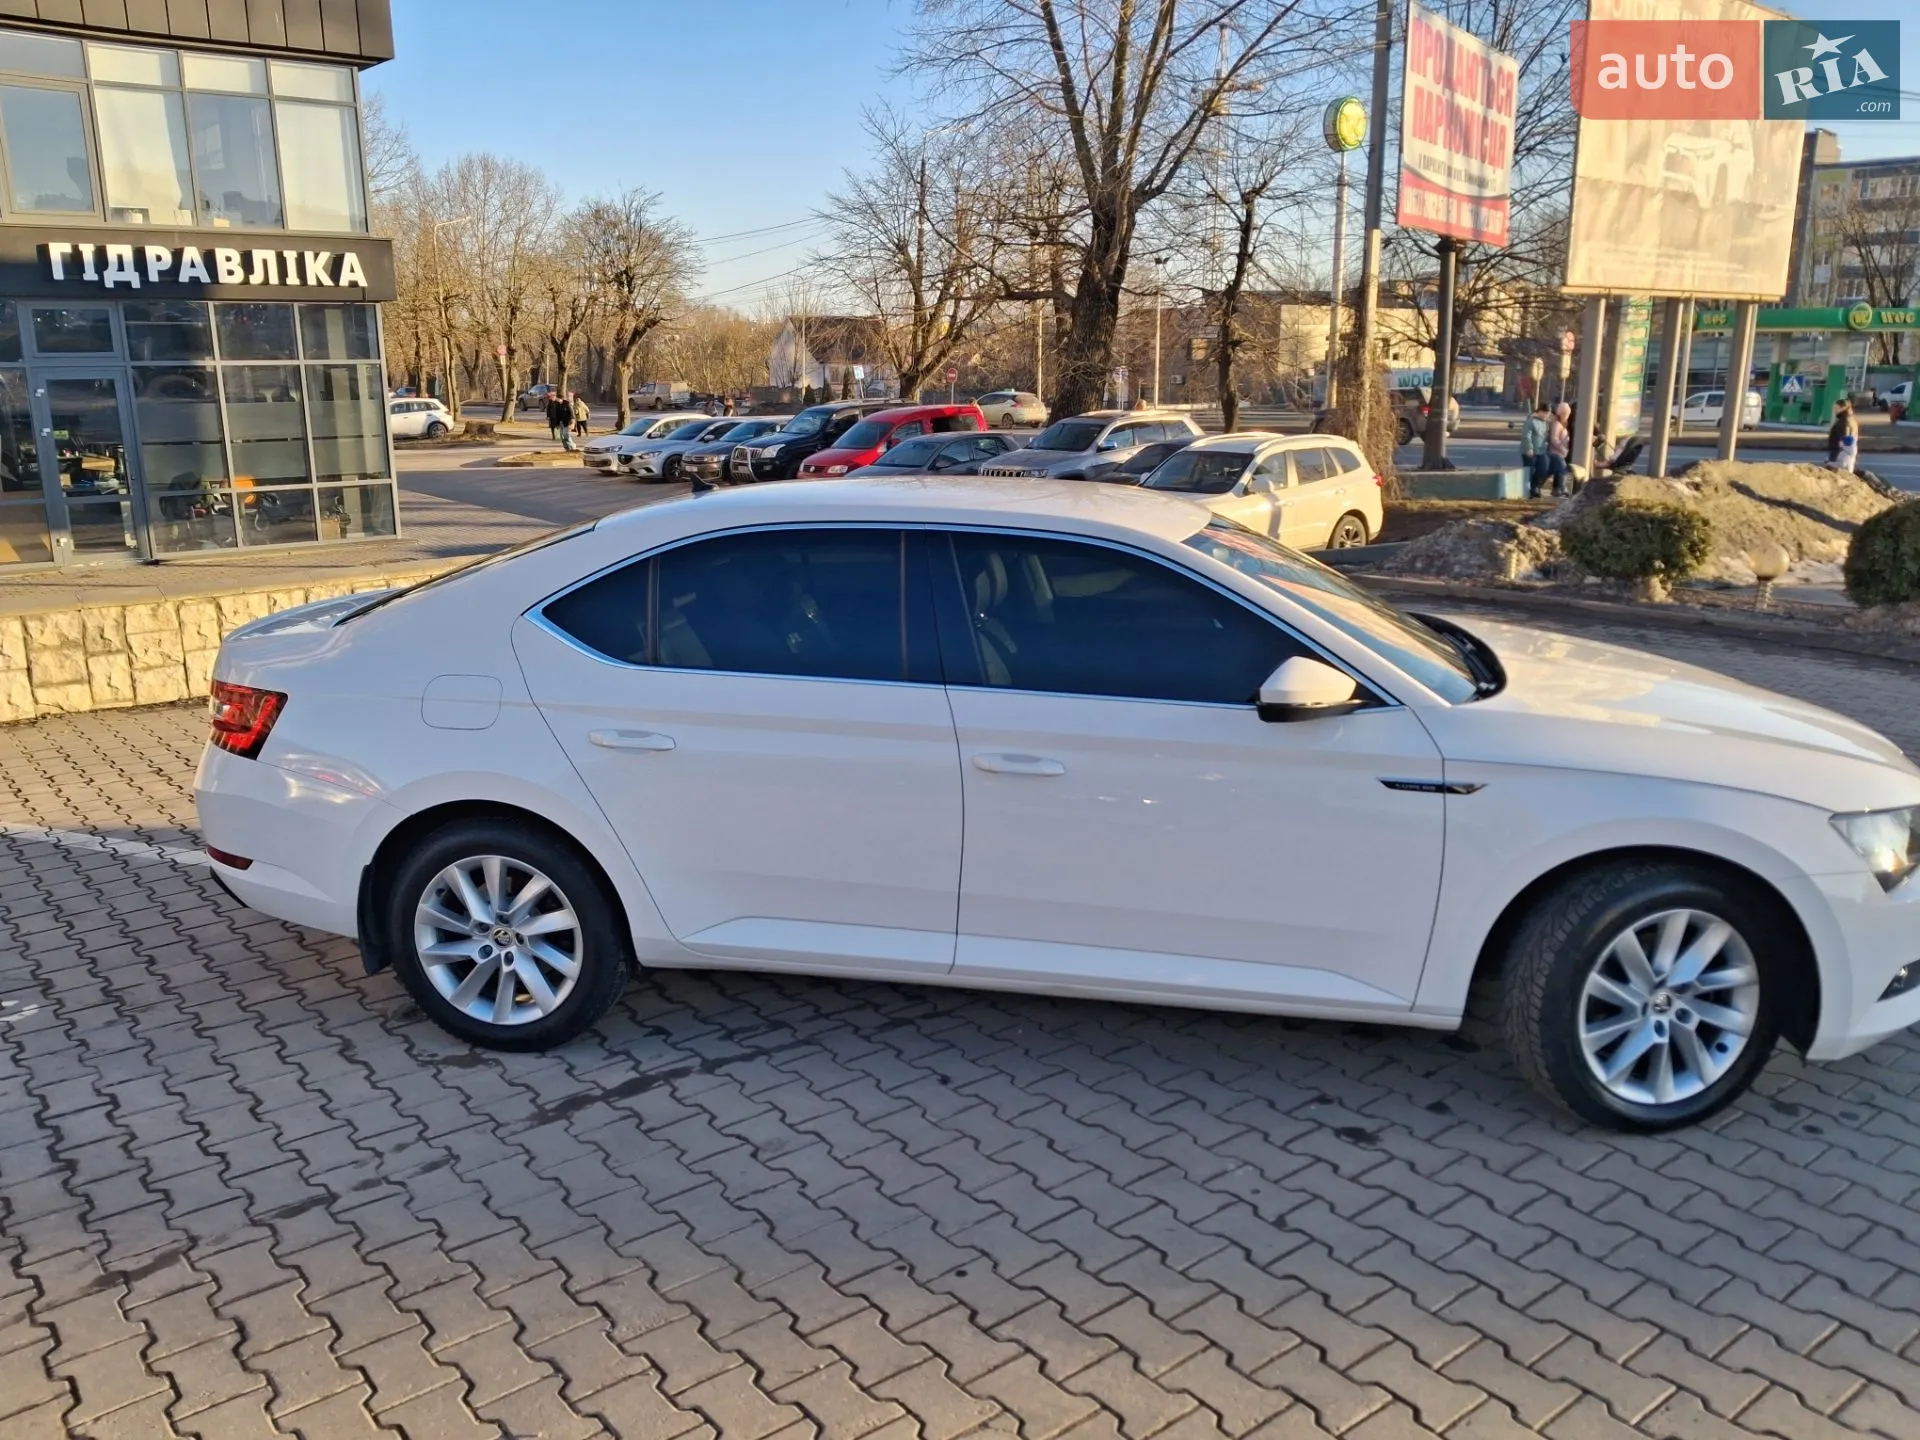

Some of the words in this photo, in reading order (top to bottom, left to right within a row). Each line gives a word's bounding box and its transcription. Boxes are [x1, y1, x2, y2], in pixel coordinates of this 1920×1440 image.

[1410, 15, 1514, 118] ПРОДАЮТЬСЯ
[1412, 85, 1507, 174] ПАРКОМІСЦЯ
[47, 241, 369, 289] ГІДРАВЛІКА
